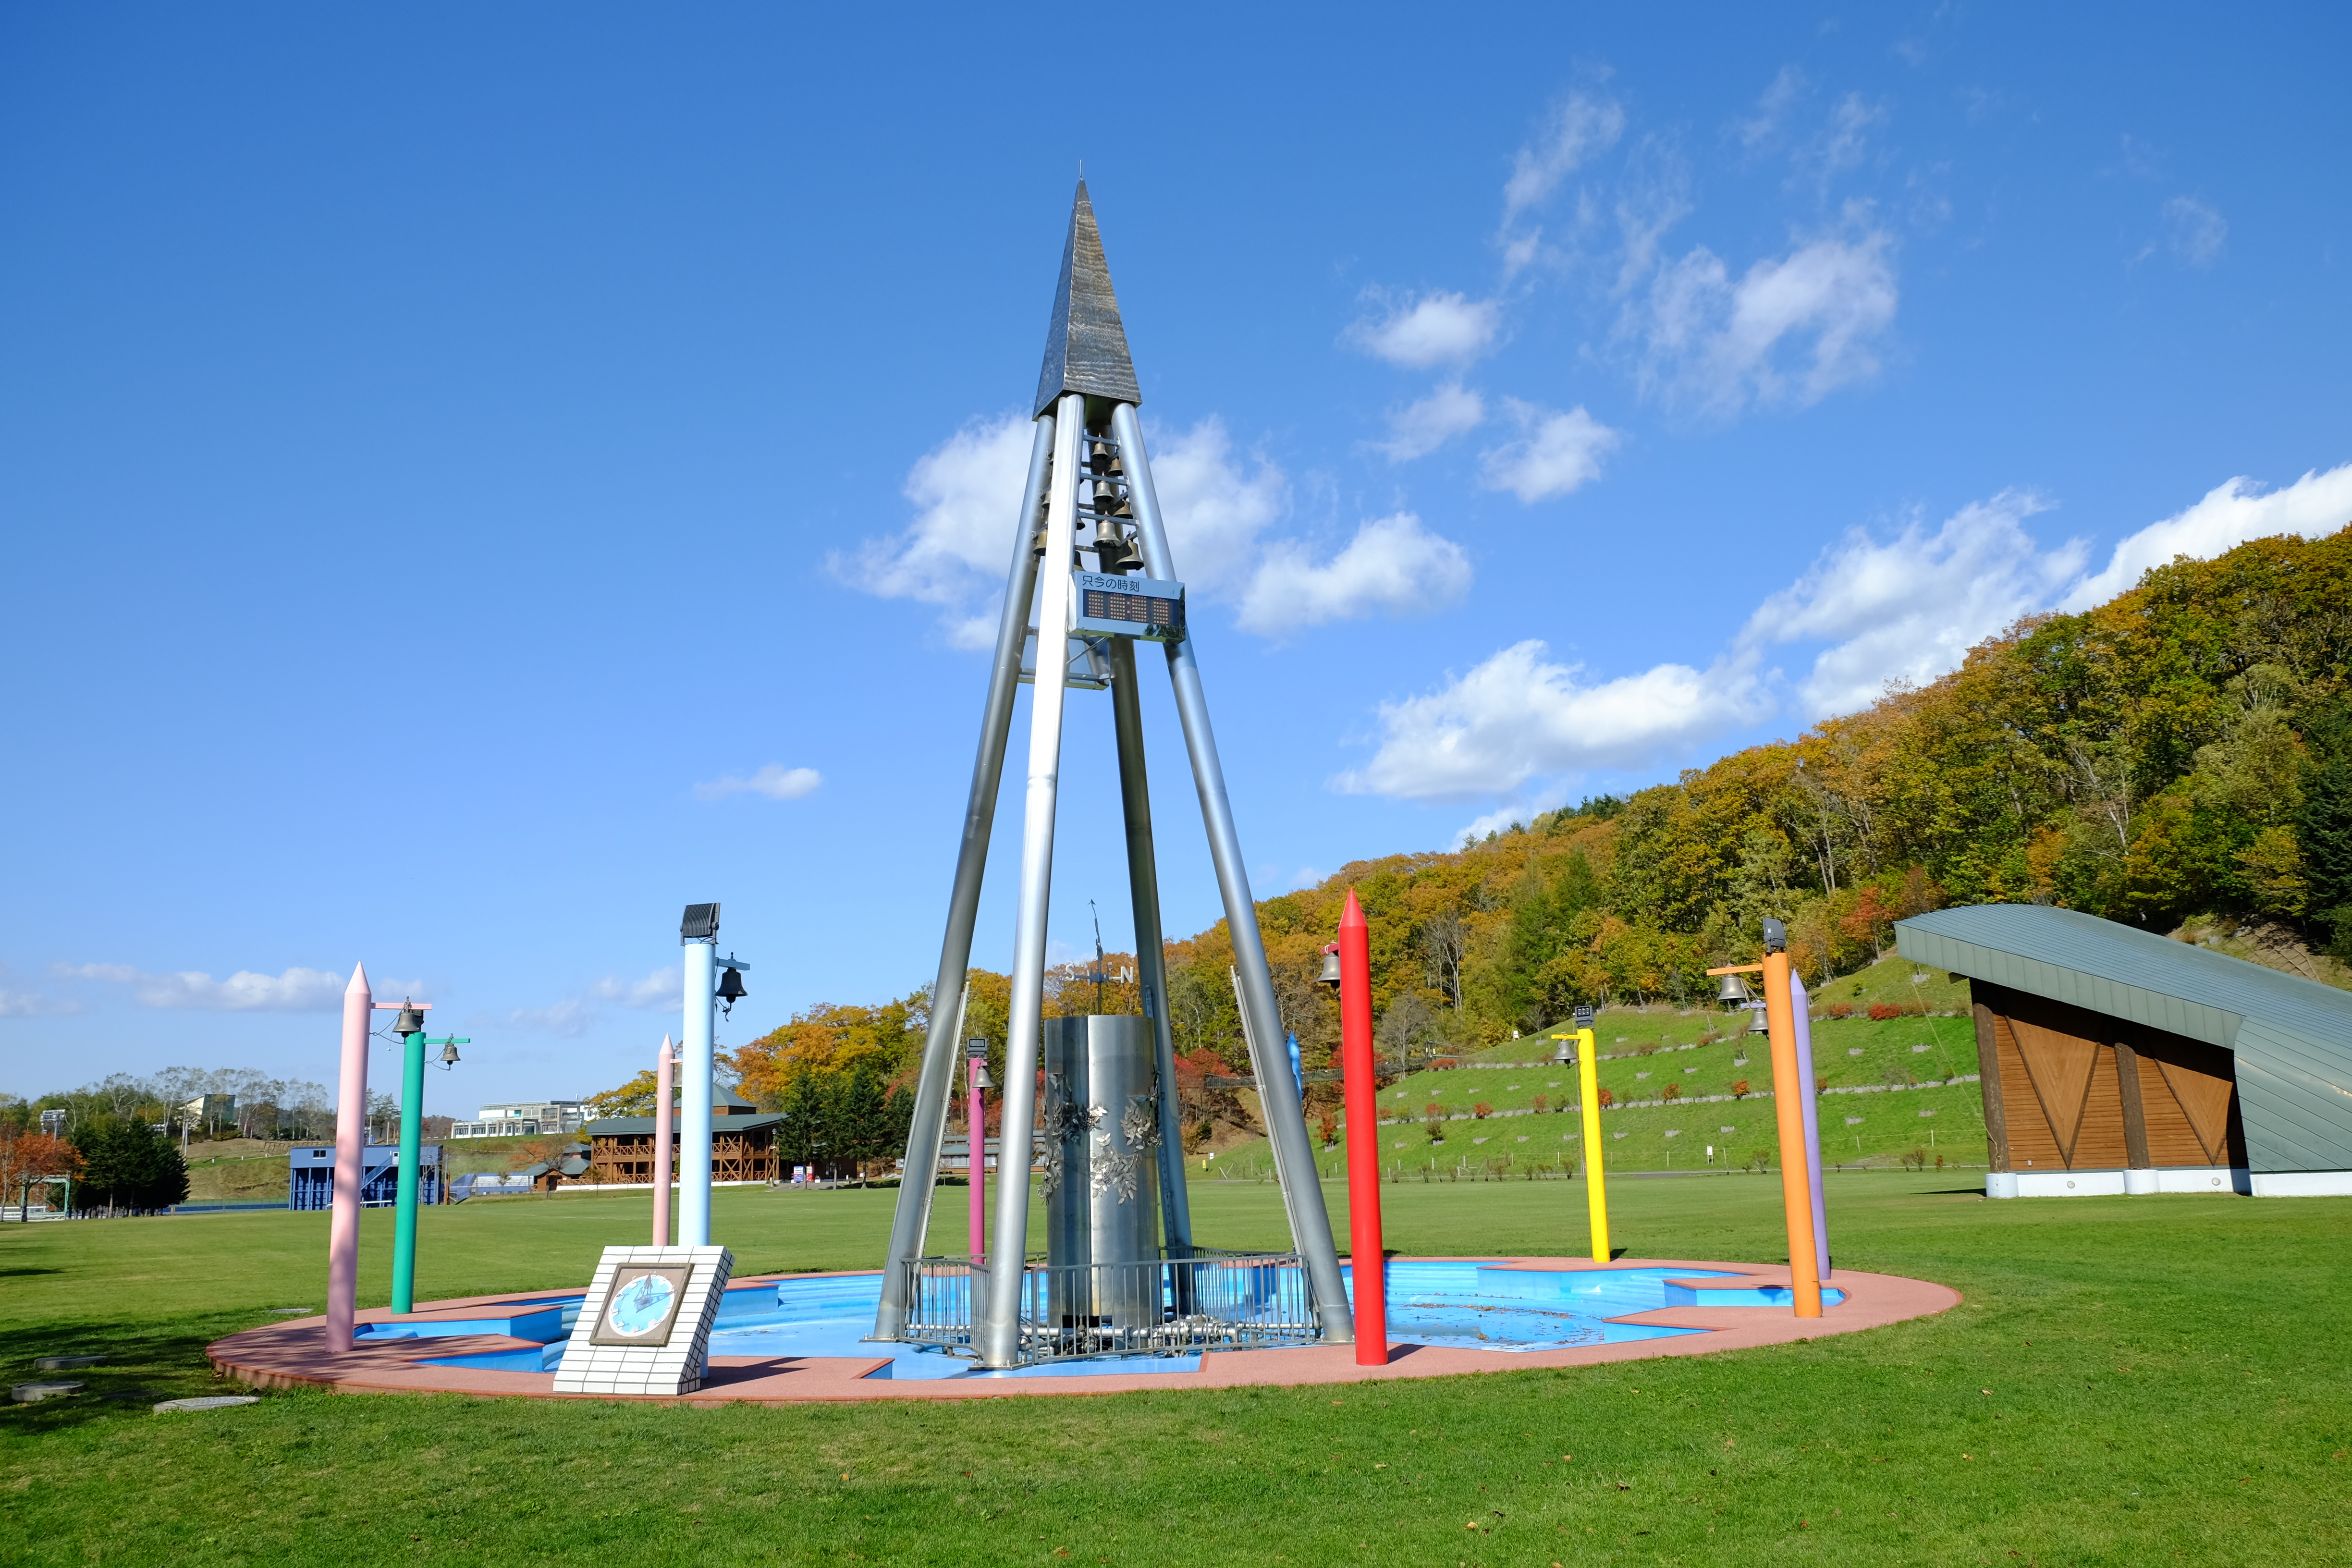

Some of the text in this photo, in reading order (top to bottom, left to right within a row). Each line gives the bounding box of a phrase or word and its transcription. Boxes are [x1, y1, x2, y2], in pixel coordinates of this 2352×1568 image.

[1083, 576, 1139, 591] 只今の時刻
[1065, 964, 1075, 981] S
[1121, 966, 1133, 983] N
